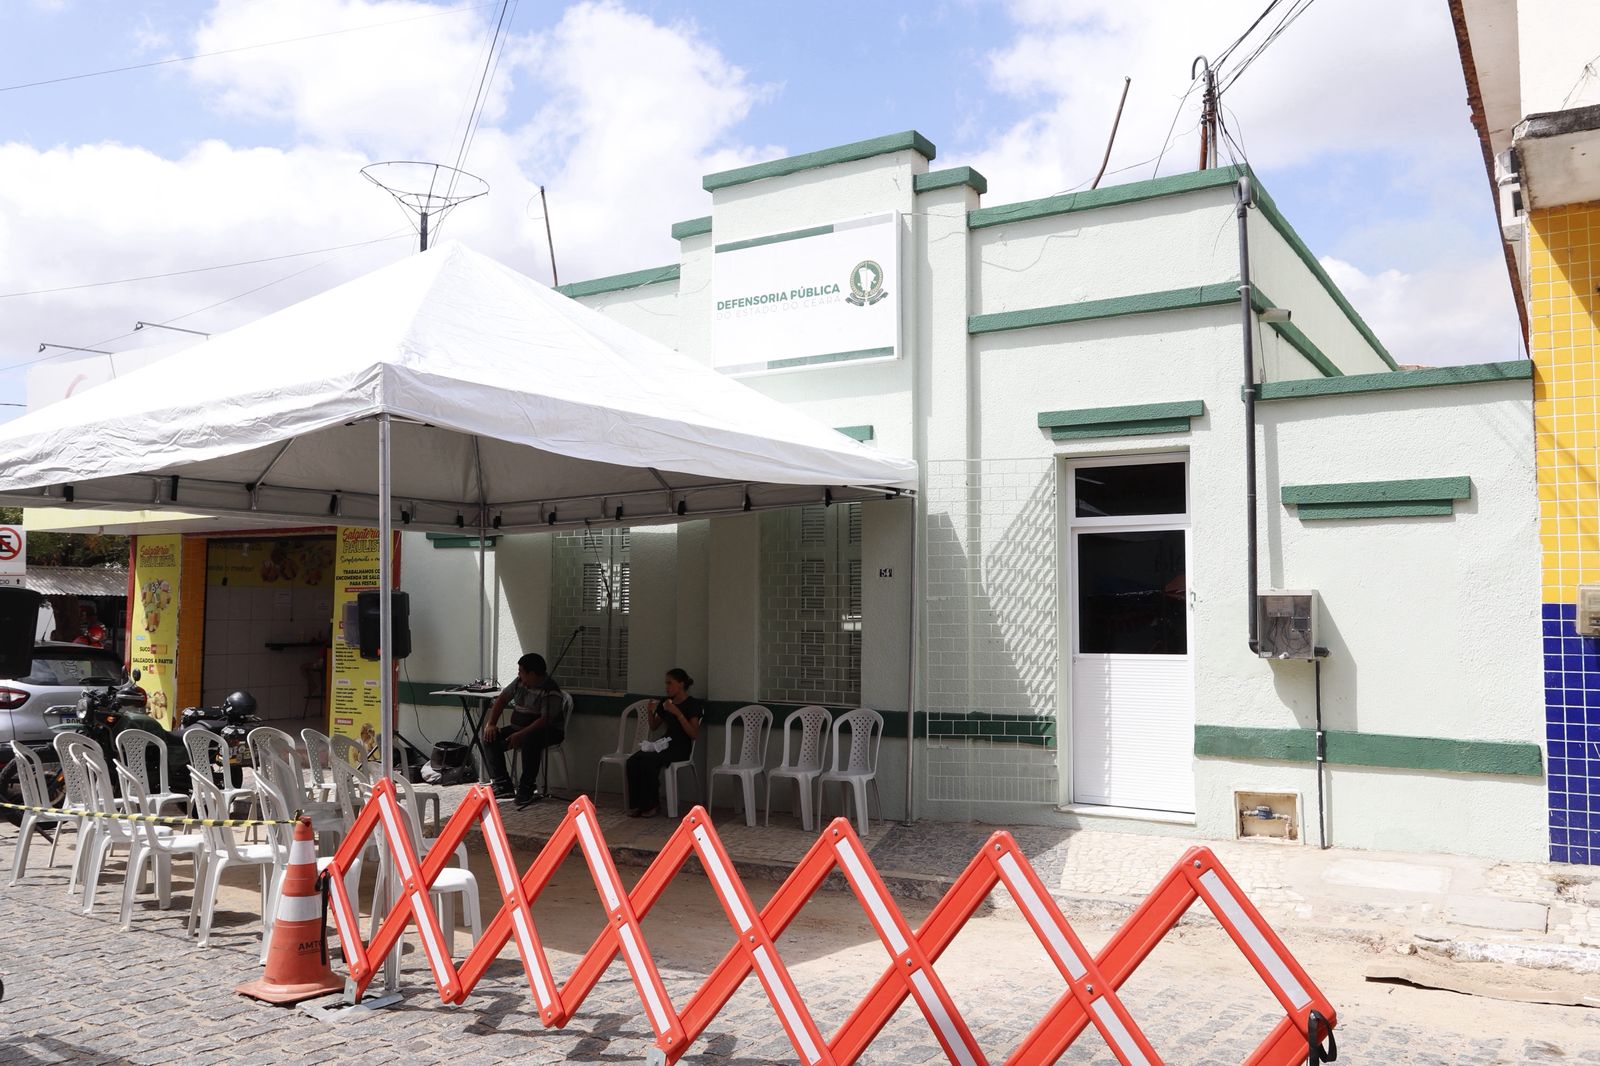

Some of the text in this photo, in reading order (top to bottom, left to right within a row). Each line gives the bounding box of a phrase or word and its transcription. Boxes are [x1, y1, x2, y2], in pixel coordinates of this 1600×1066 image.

[716, 282, 841, 311] DEFENSORIA PÚBLICA
[735, 303, 778, 318] ESTADO
[343, 539, 380, 553] PAULIST
[298, 940, 322, 951] AMT
